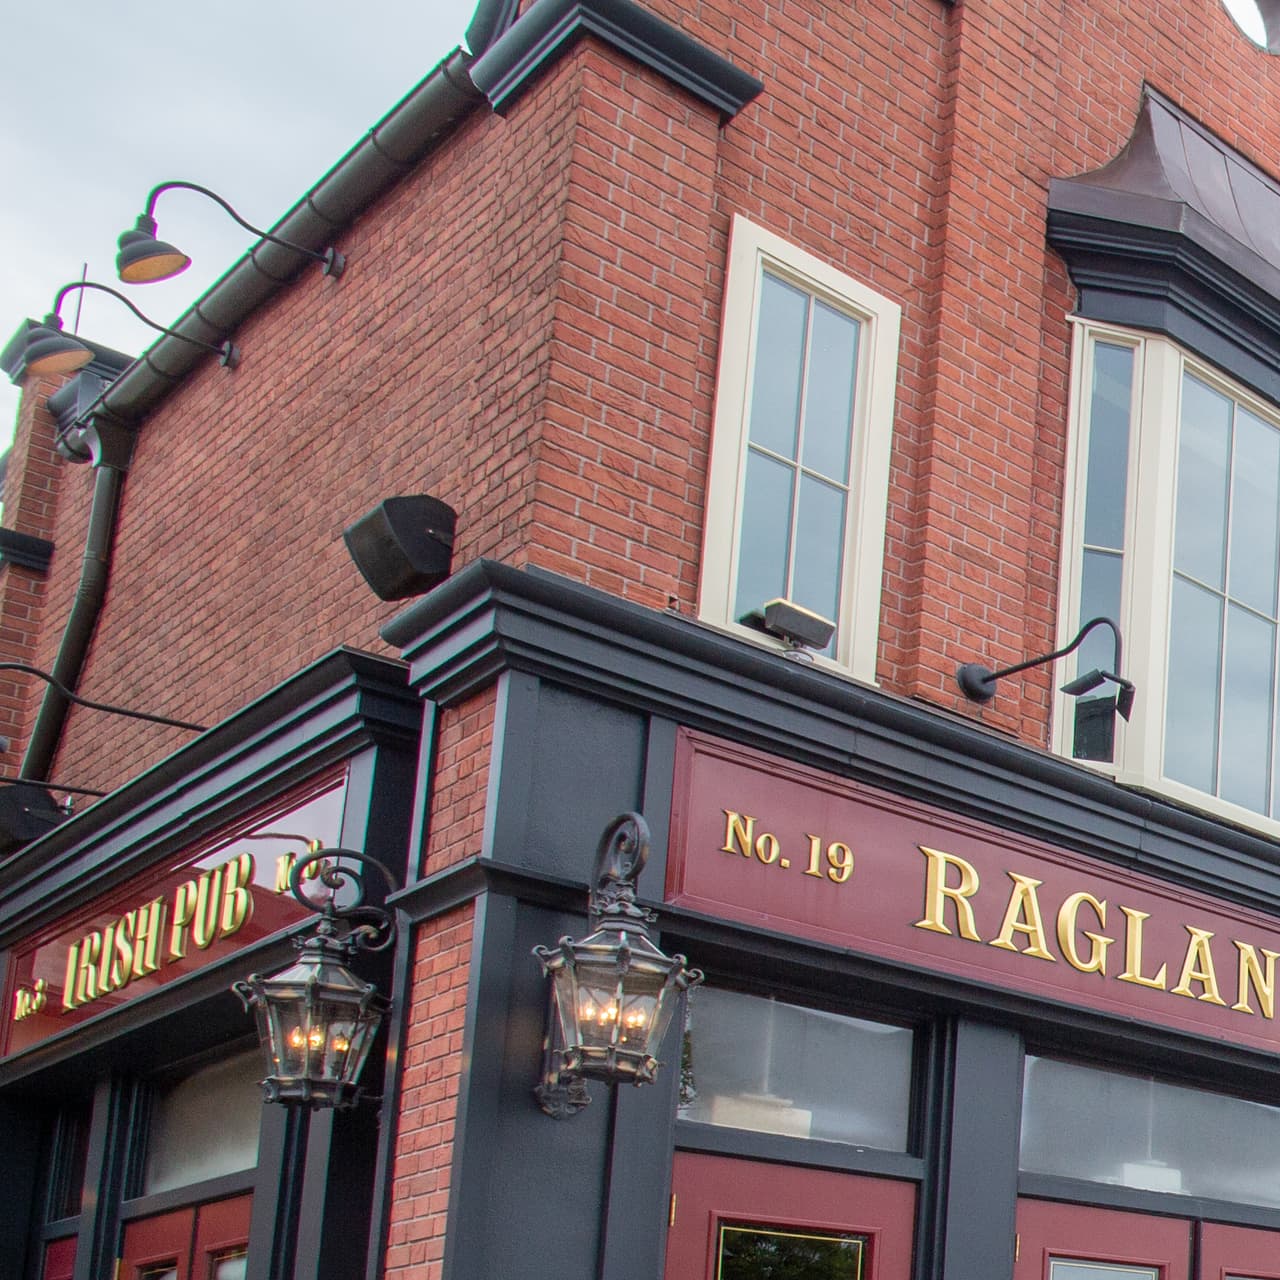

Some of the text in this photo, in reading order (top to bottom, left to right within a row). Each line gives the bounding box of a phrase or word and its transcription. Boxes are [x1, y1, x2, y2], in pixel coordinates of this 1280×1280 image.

[721, 808, 855, 884] No. 19
[62, 895, 166, 1014] IRISH
[168, 852, 255, 963] PUB
